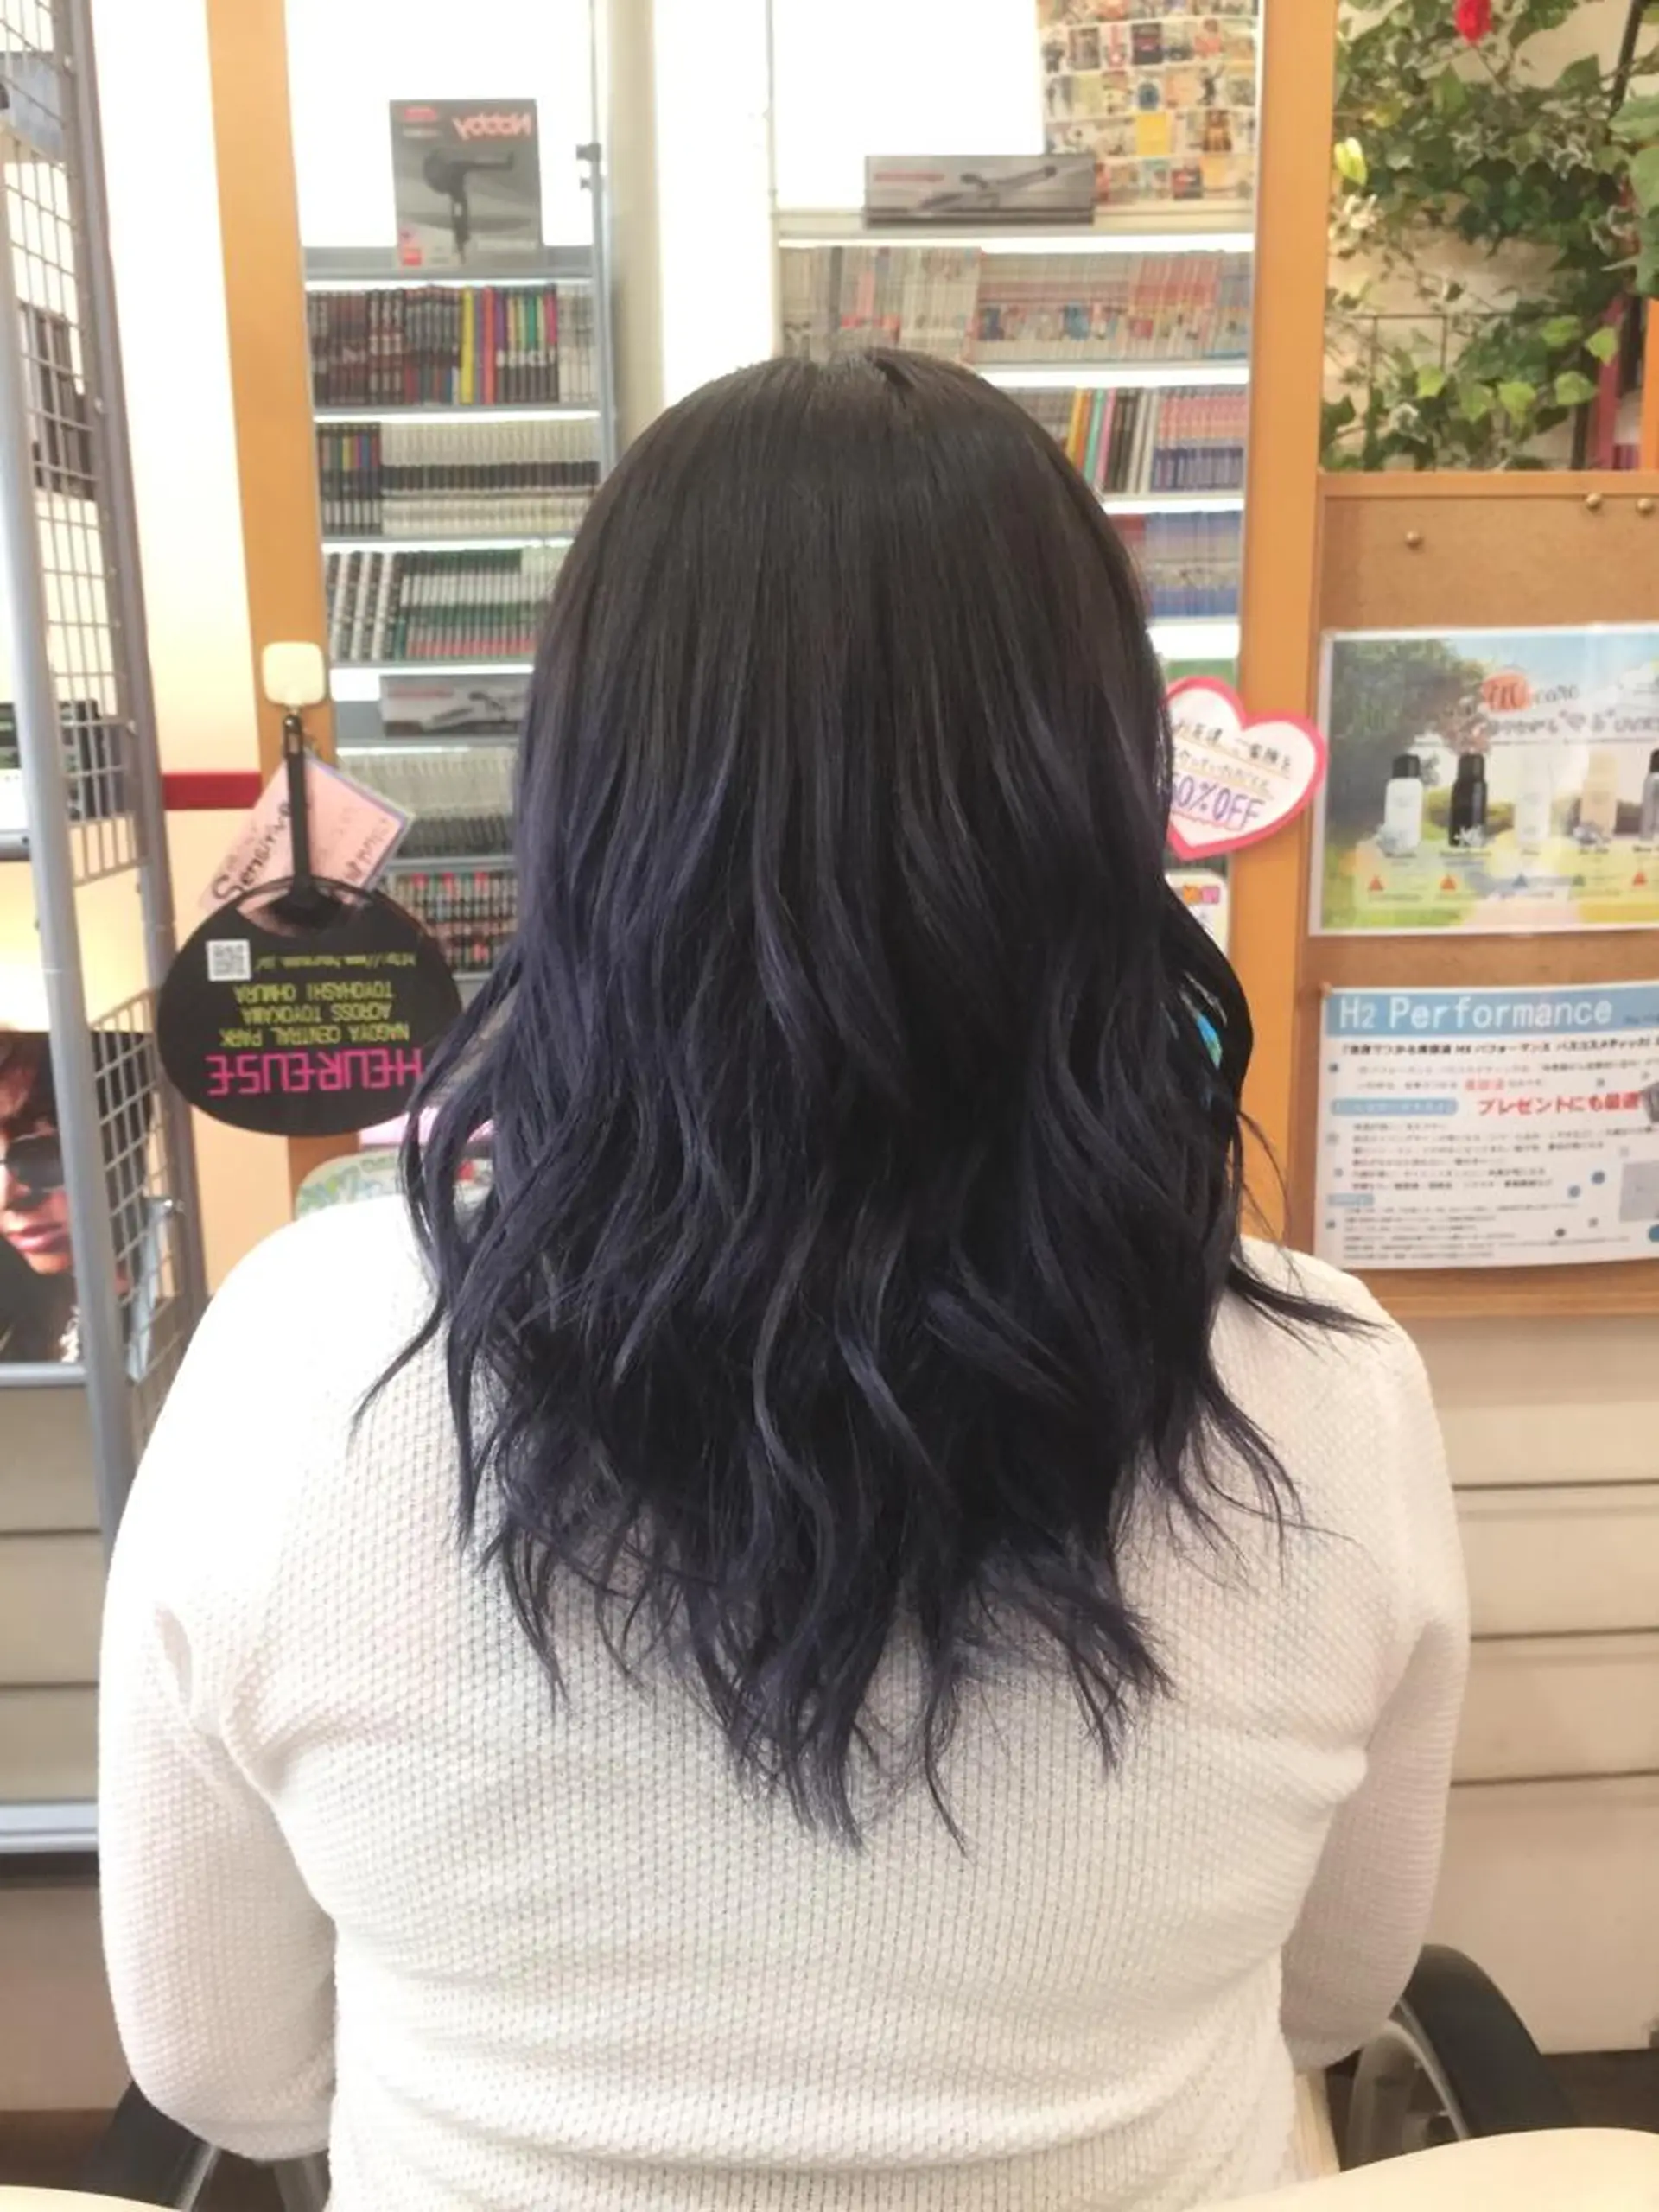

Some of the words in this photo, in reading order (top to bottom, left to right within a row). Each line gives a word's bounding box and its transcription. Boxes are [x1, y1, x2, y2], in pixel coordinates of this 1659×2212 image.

[330, 1002, 392, 1022] ACROSS
[1339, 997, 1376, 1029] H2
[1389, 995, 1613, 1029] Performance
[219, 1027, 263, 1047] PARK
[270, 1025, 341, 1046] CENTRAL
[347, 1023, 410, 1043] NAGOYA
[205, 1048, 423, 1096] HEUREUSE
[1478, 1090, 1642, 1116] プレゼントにも最適
